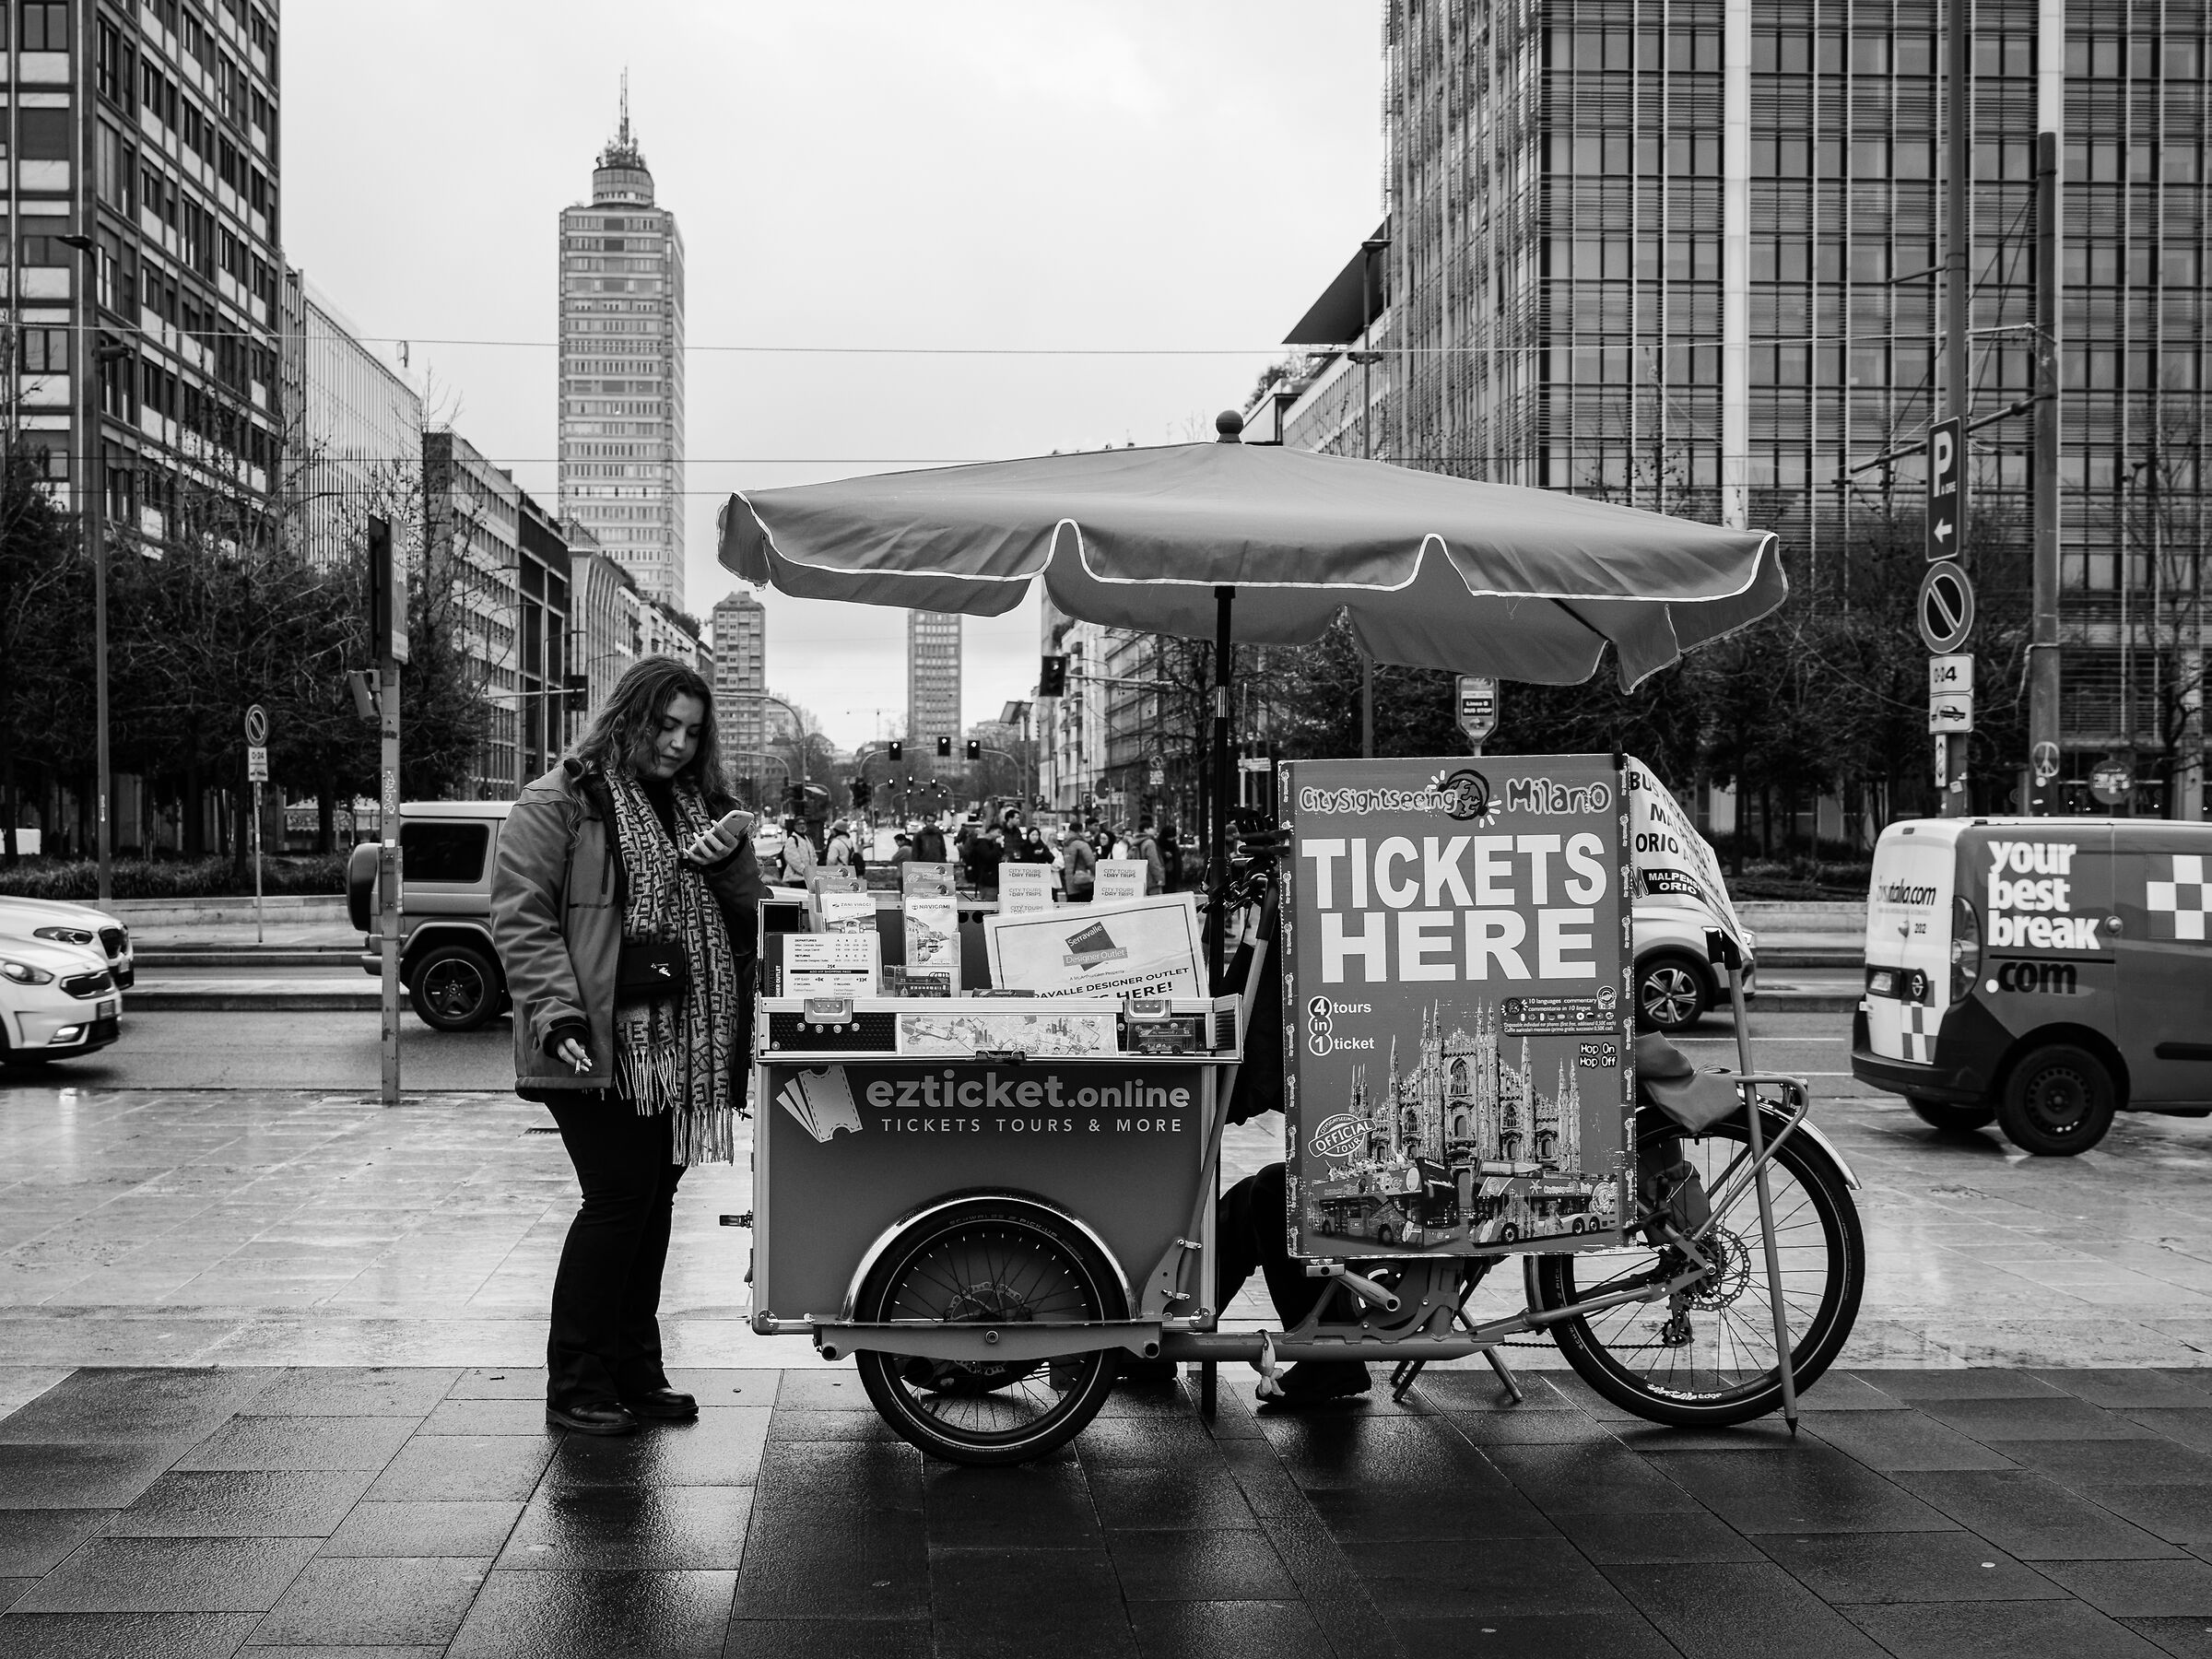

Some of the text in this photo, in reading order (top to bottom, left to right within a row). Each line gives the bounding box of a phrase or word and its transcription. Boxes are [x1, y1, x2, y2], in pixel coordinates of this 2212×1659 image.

[1934, 430, 1953, 498] P
[1630, 771, 1660, 798] BUS
[1299, 777, 1612, 815] CitySightseeing Milano
[1635, 832, 1679, 854] ORIO
[1986, 841, 2077, 875] your
[1301, 832, 1607, 909] TICKETS
[1659, 882, 1698, 895] ORIO
[1987, 873, 2072, 912] best
[1066, 924, 1103, 947] Serravalle
[1987, 909, 2100, 950] break
[1065, 948, 1125, 964] Designer Outlet
[1321, 908, 1596, 982] HERE
[1086, 976, 1143, 992] DESIGNER
[1146, 968, 1189, 981] OUTLET
[1116, 981, 1173, 999] HERE!
[1313, 999, 1372, 1015] 4 tours
[1313, 1019, 1327, 1030] in
[1314, 1036, 1375, 1053] 1 ticket
[1581, 1042, 1616, 1054] Hop On
[1580, 1056, 1617, 1067] Hop Off
[866, 1069, 1190, 1107] ezticket.online
[881, 1118, 1182, 1132] TICKETS TOURS & MORE
[1315, 1121, 1373, 1151] OFFICIAL
[1335, 1137, 1361, 1153] TOUR
[1019, 1218, 1058, 1238] PICK-UP
